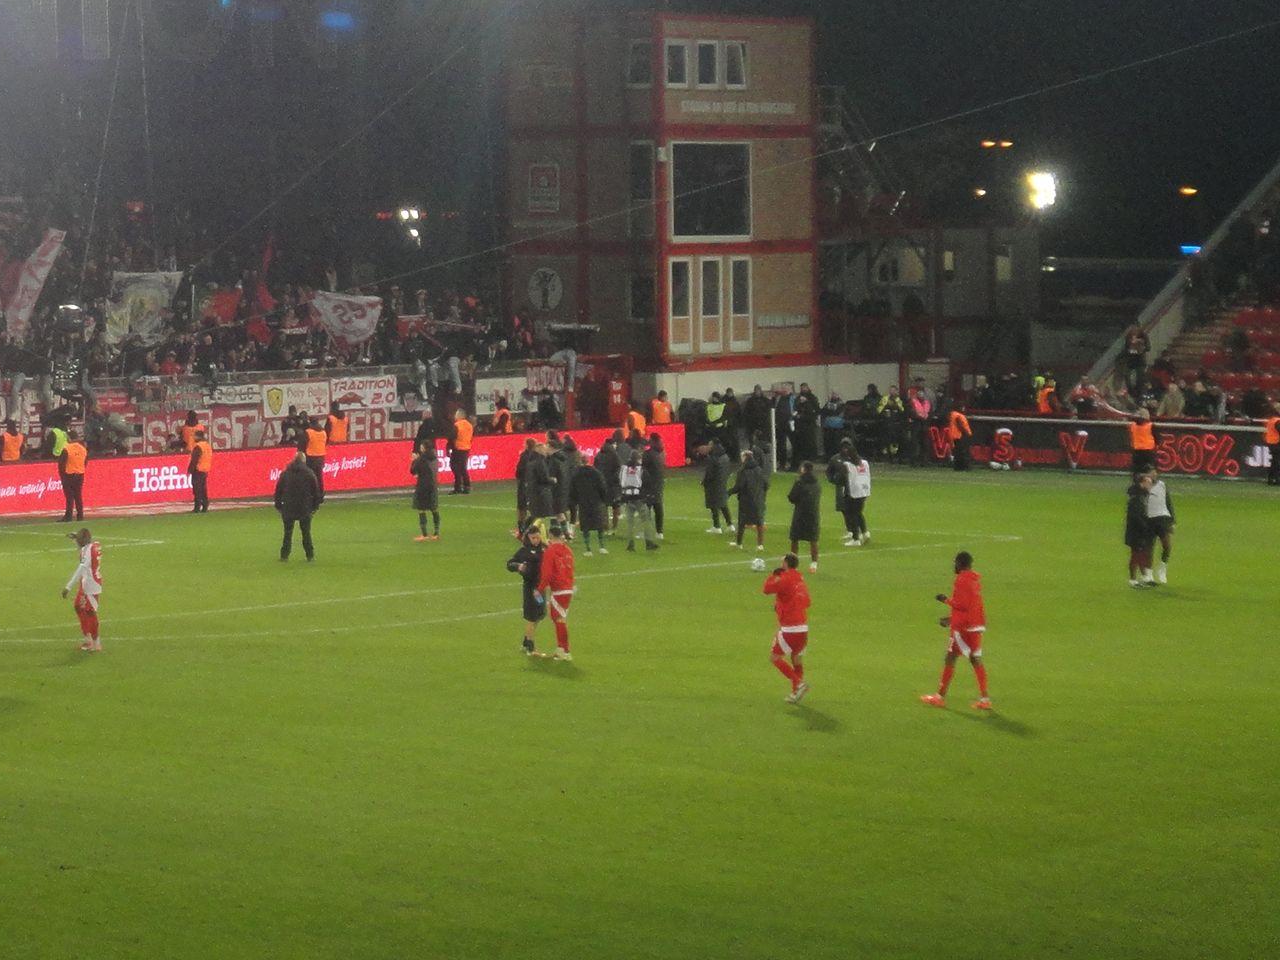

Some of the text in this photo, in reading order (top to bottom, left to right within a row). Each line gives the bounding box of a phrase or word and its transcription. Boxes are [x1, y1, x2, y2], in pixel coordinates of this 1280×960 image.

[332, 377, 395, 392] TRADITION
[371, 392, 396, 405] 2.0
[1156, 433, 1240, 477] 50%
[19, 479, 47, 499] wenig
[133, 466, 193, 493] Höffn
